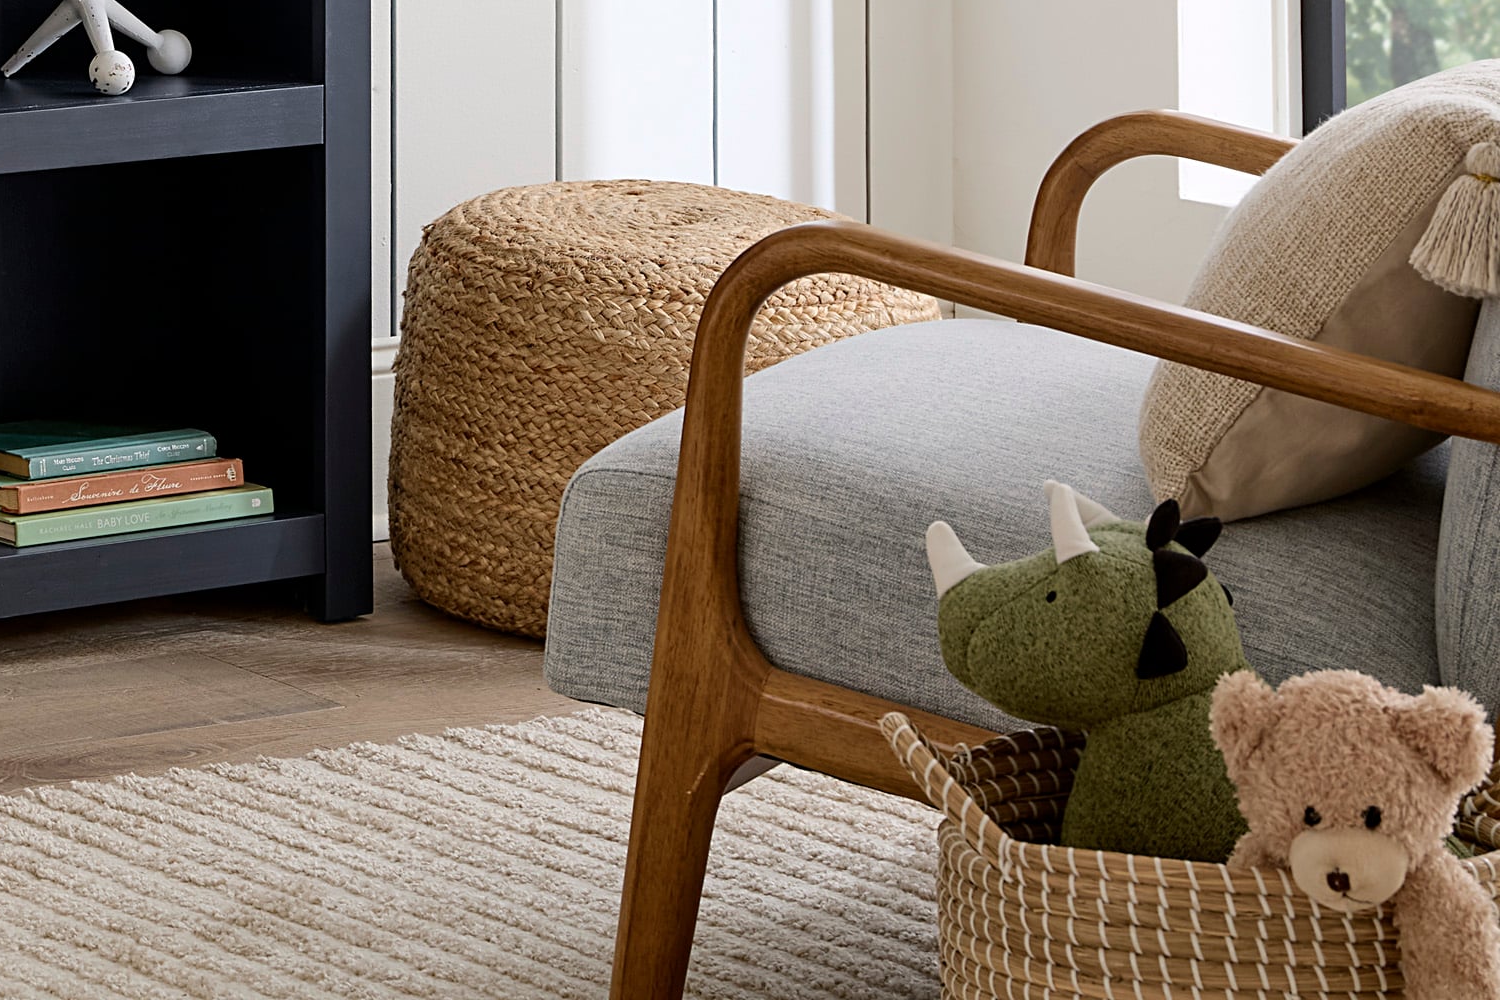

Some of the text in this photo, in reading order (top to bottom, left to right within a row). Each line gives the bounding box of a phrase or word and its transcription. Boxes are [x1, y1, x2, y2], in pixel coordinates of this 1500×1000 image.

[92, 456, 103, 466] The
[104, 454, 133, 464] Christmas
[129, 483, 140, 494] de
[97, 516, 122, 529] BABY
[124, 512, 150, 525] LOVE
